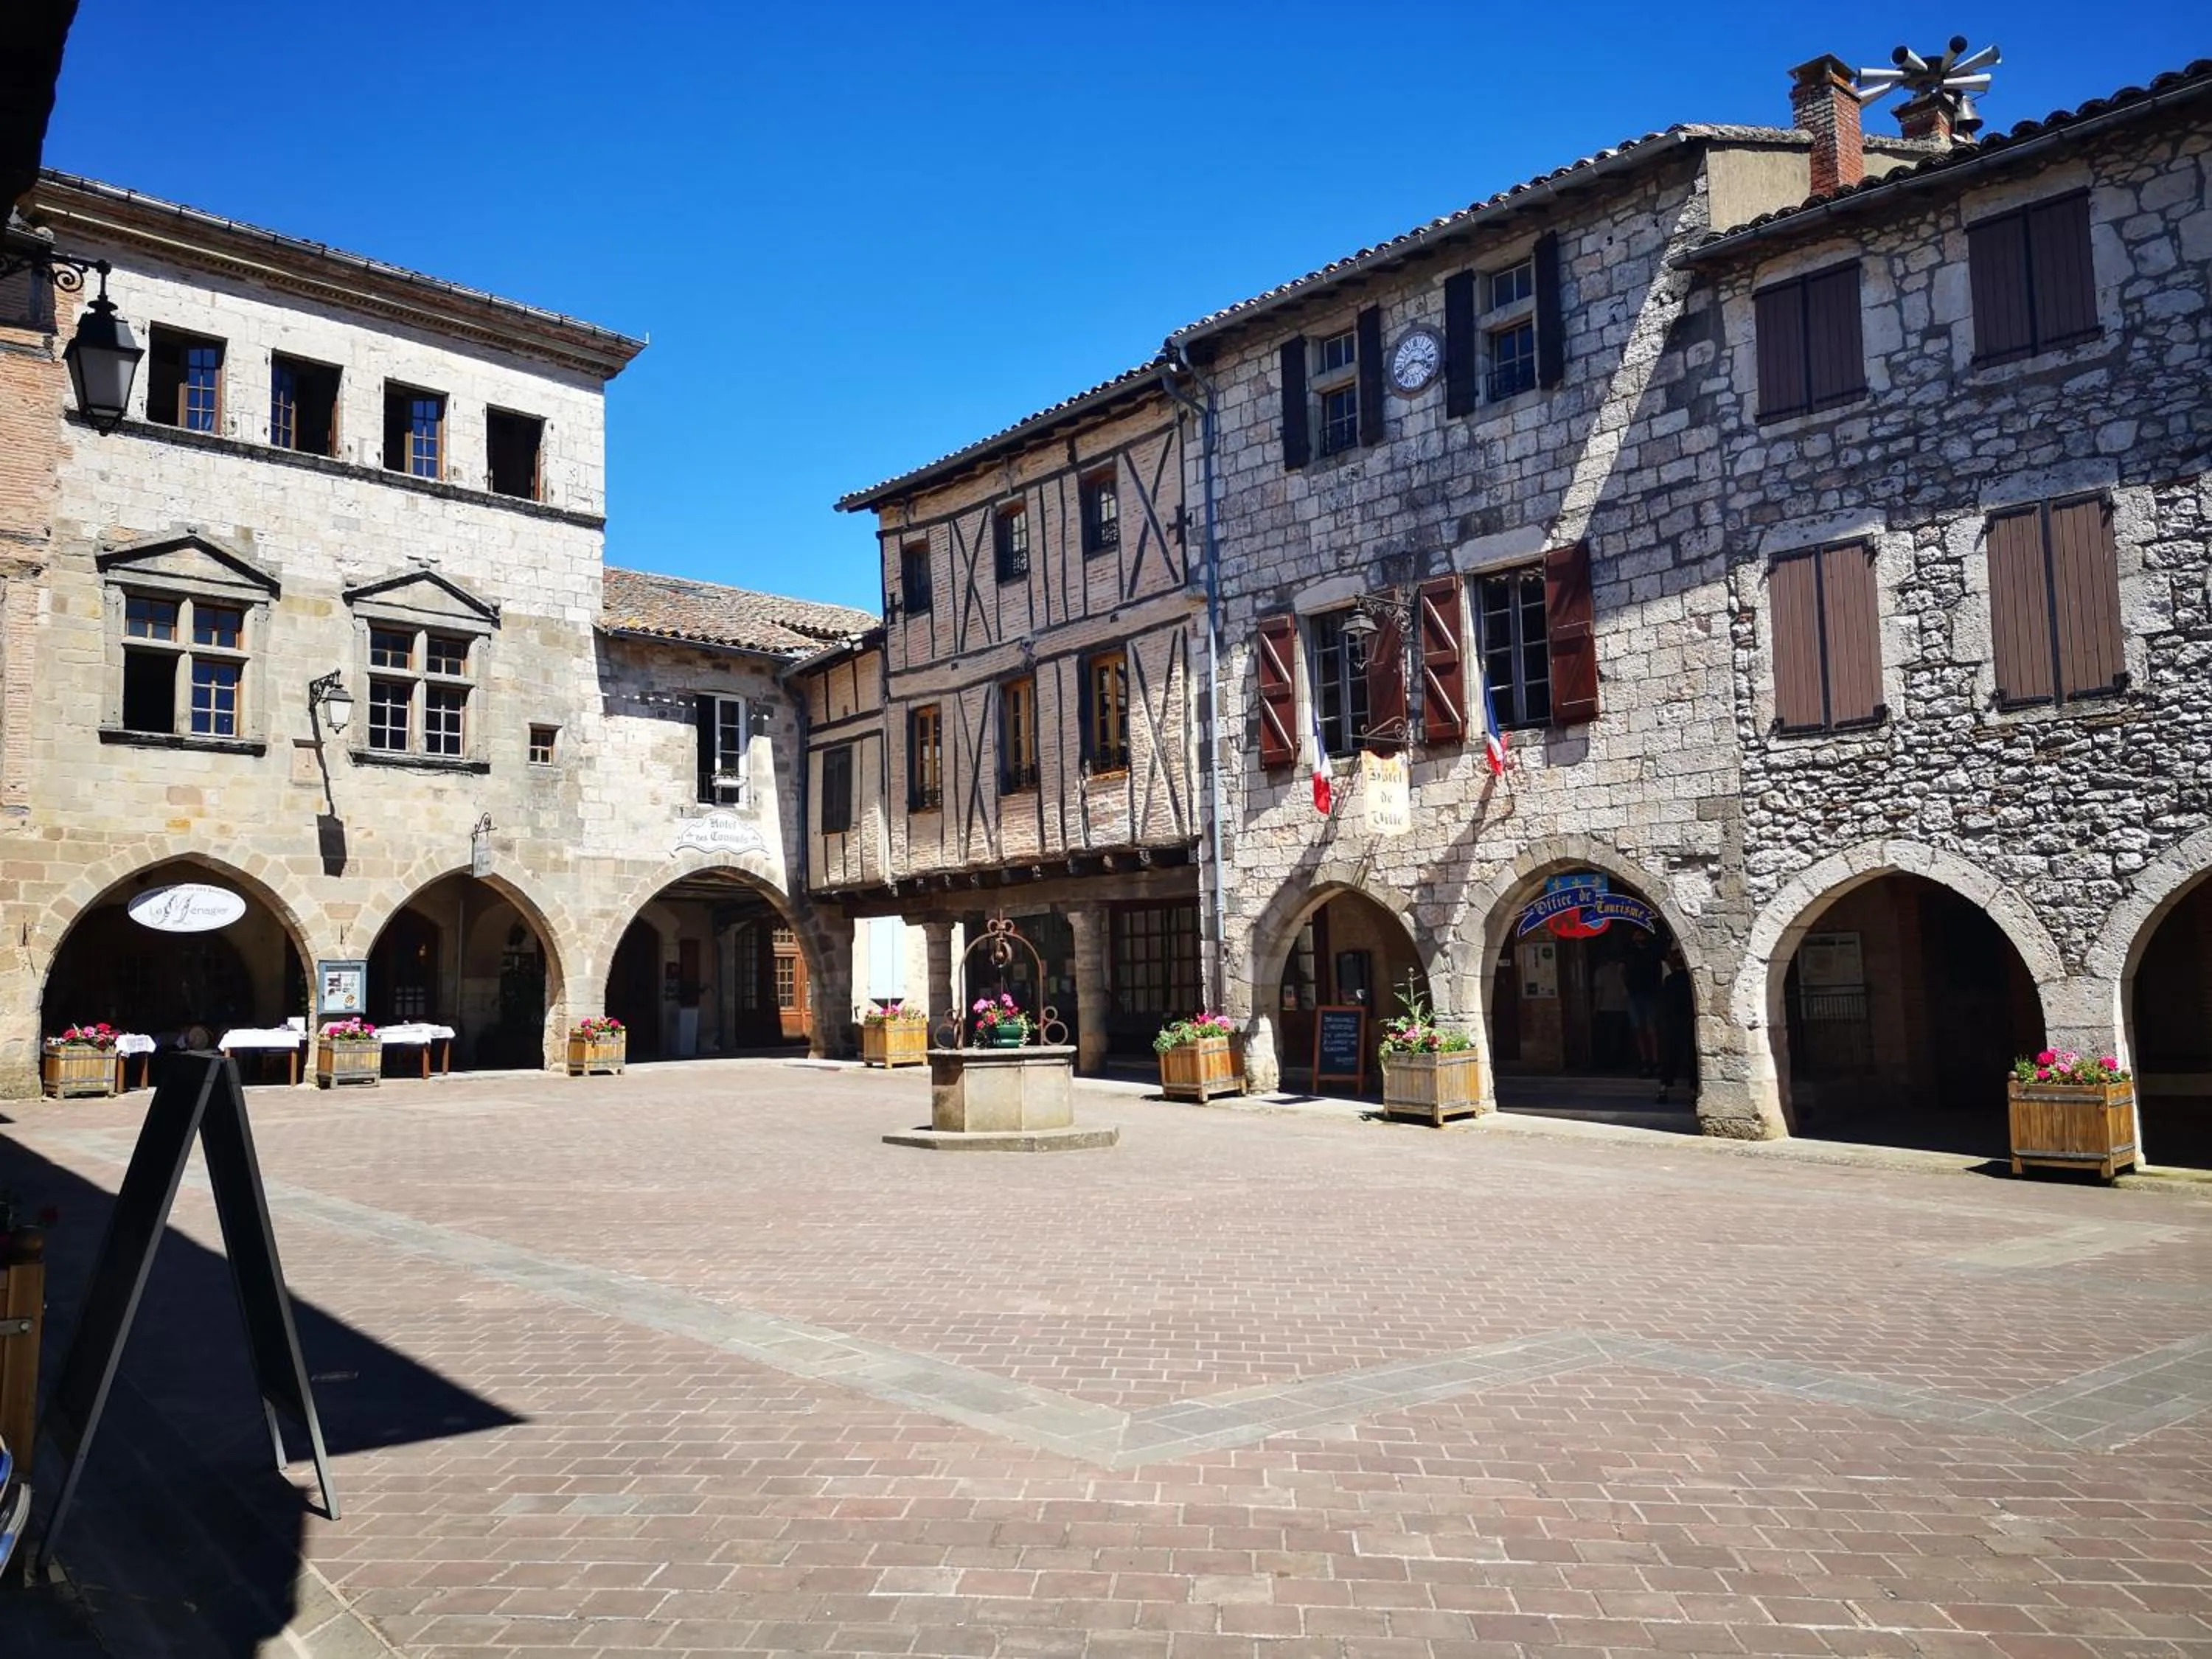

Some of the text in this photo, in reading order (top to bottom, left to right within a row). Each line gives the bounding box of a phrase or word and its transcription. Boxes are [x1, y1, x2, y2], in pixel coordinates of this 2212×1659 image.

[1380, 790, 1393, 803] de
[1371, 810, 1402, 825] Ville
[1534, 888, 1592, 915] Office de
[1596, 900, 1645, 919] Tourisme
